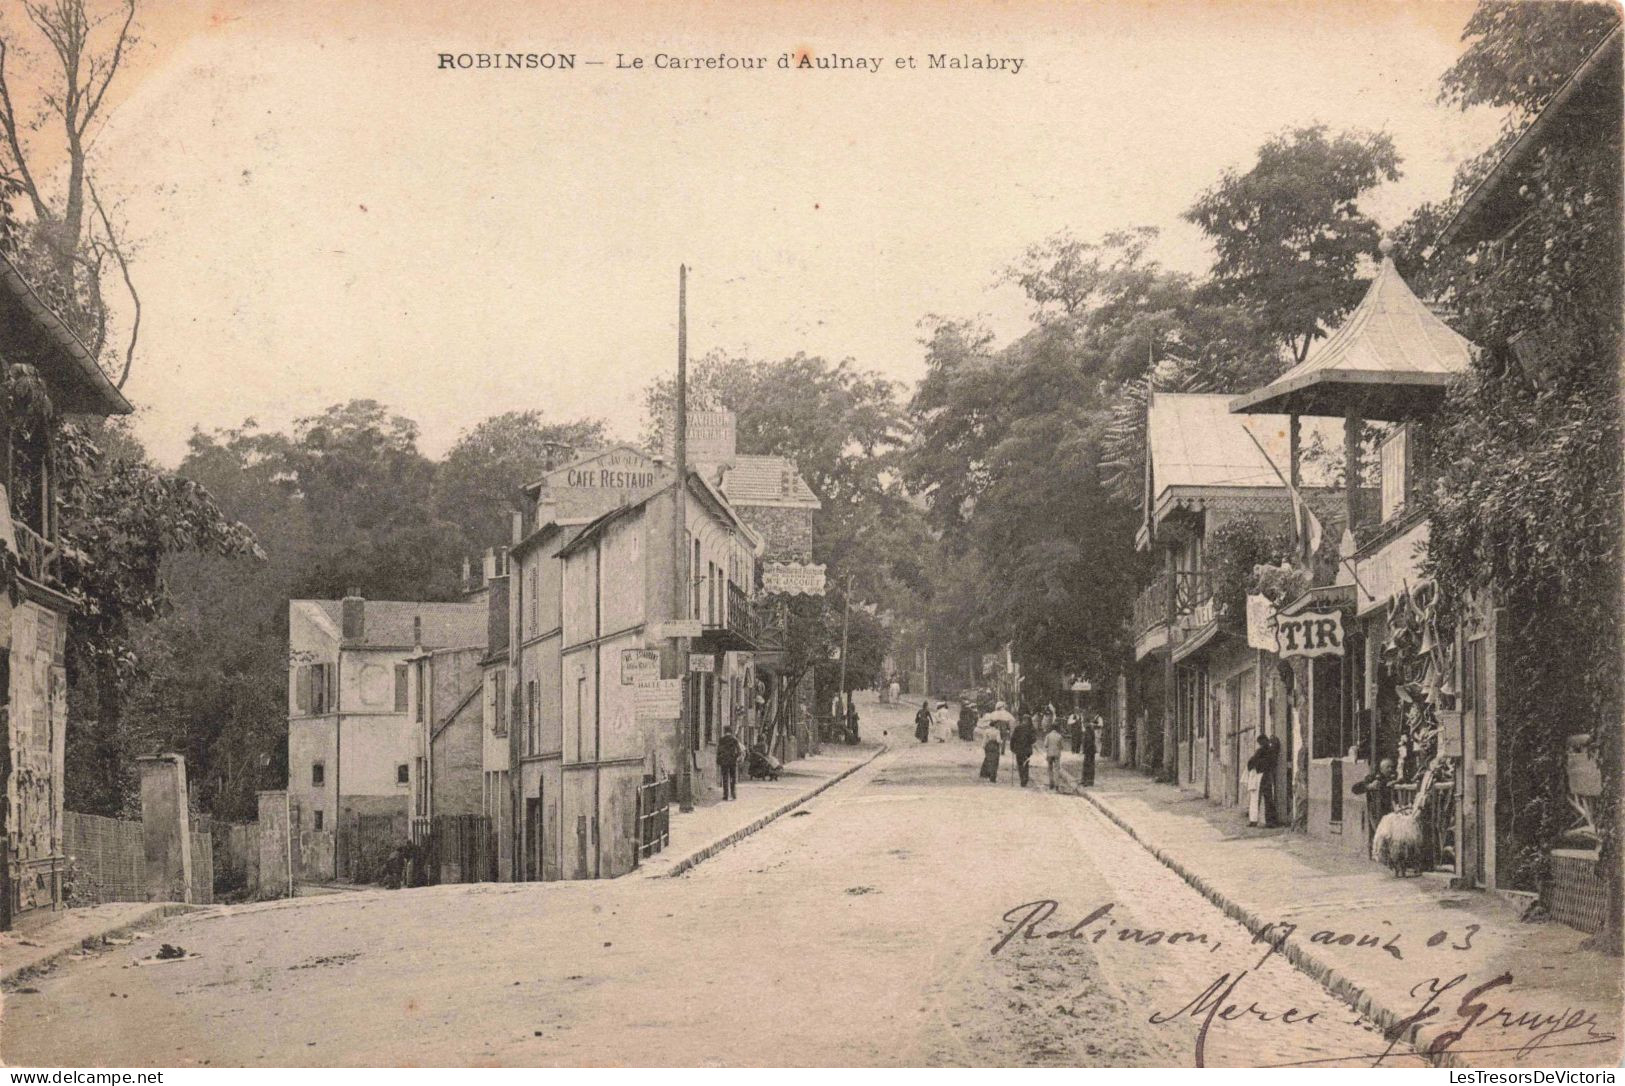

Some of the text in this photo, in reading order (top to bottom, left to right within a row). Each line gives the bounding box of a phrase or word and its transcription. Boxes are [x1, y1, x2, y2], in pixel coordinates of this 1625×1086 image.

[437, 53, 1025, 74] ROBINSON Le Carrefour d'Aulnay et Malabry
[1280, 618, 1341, 651] TIR
[1425, 923, 1476, 951] 03
